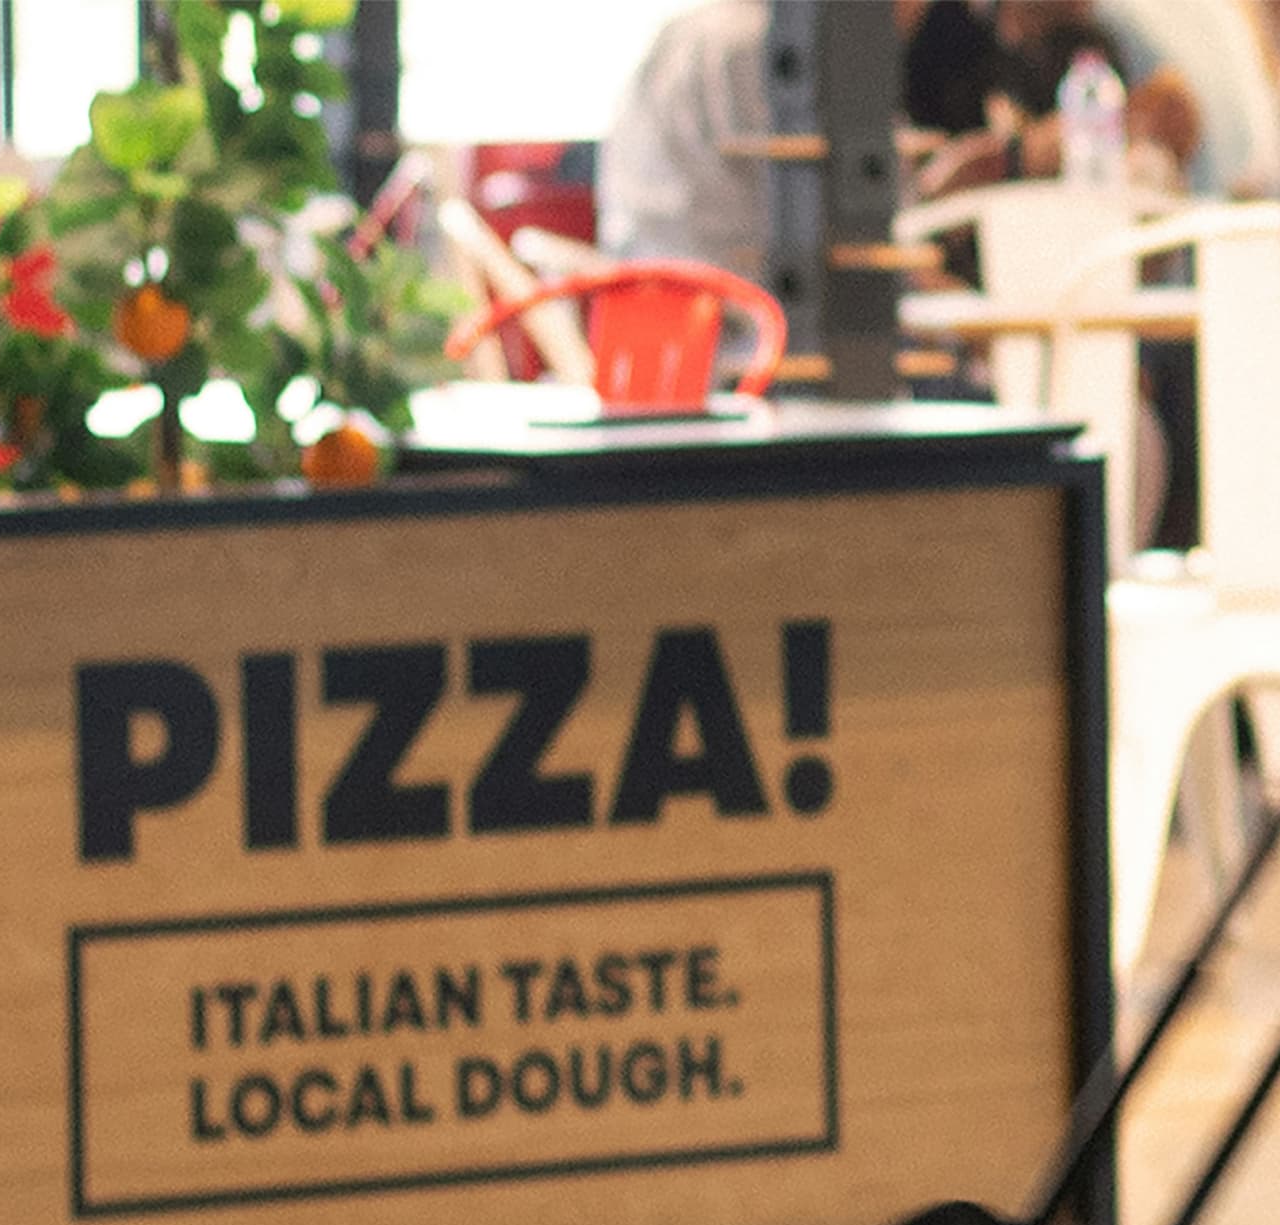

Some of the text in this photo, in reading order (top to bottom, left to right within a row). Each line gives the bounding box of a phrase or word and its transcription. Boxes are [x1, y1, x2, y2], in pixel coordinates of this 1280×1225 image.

[73, 618, 834, 865] PIZZA!
[189, 946, 742, 1049] ITALIAN TASTE.
[189, 1035, 744, 1142] LOCAL DOUGH.
